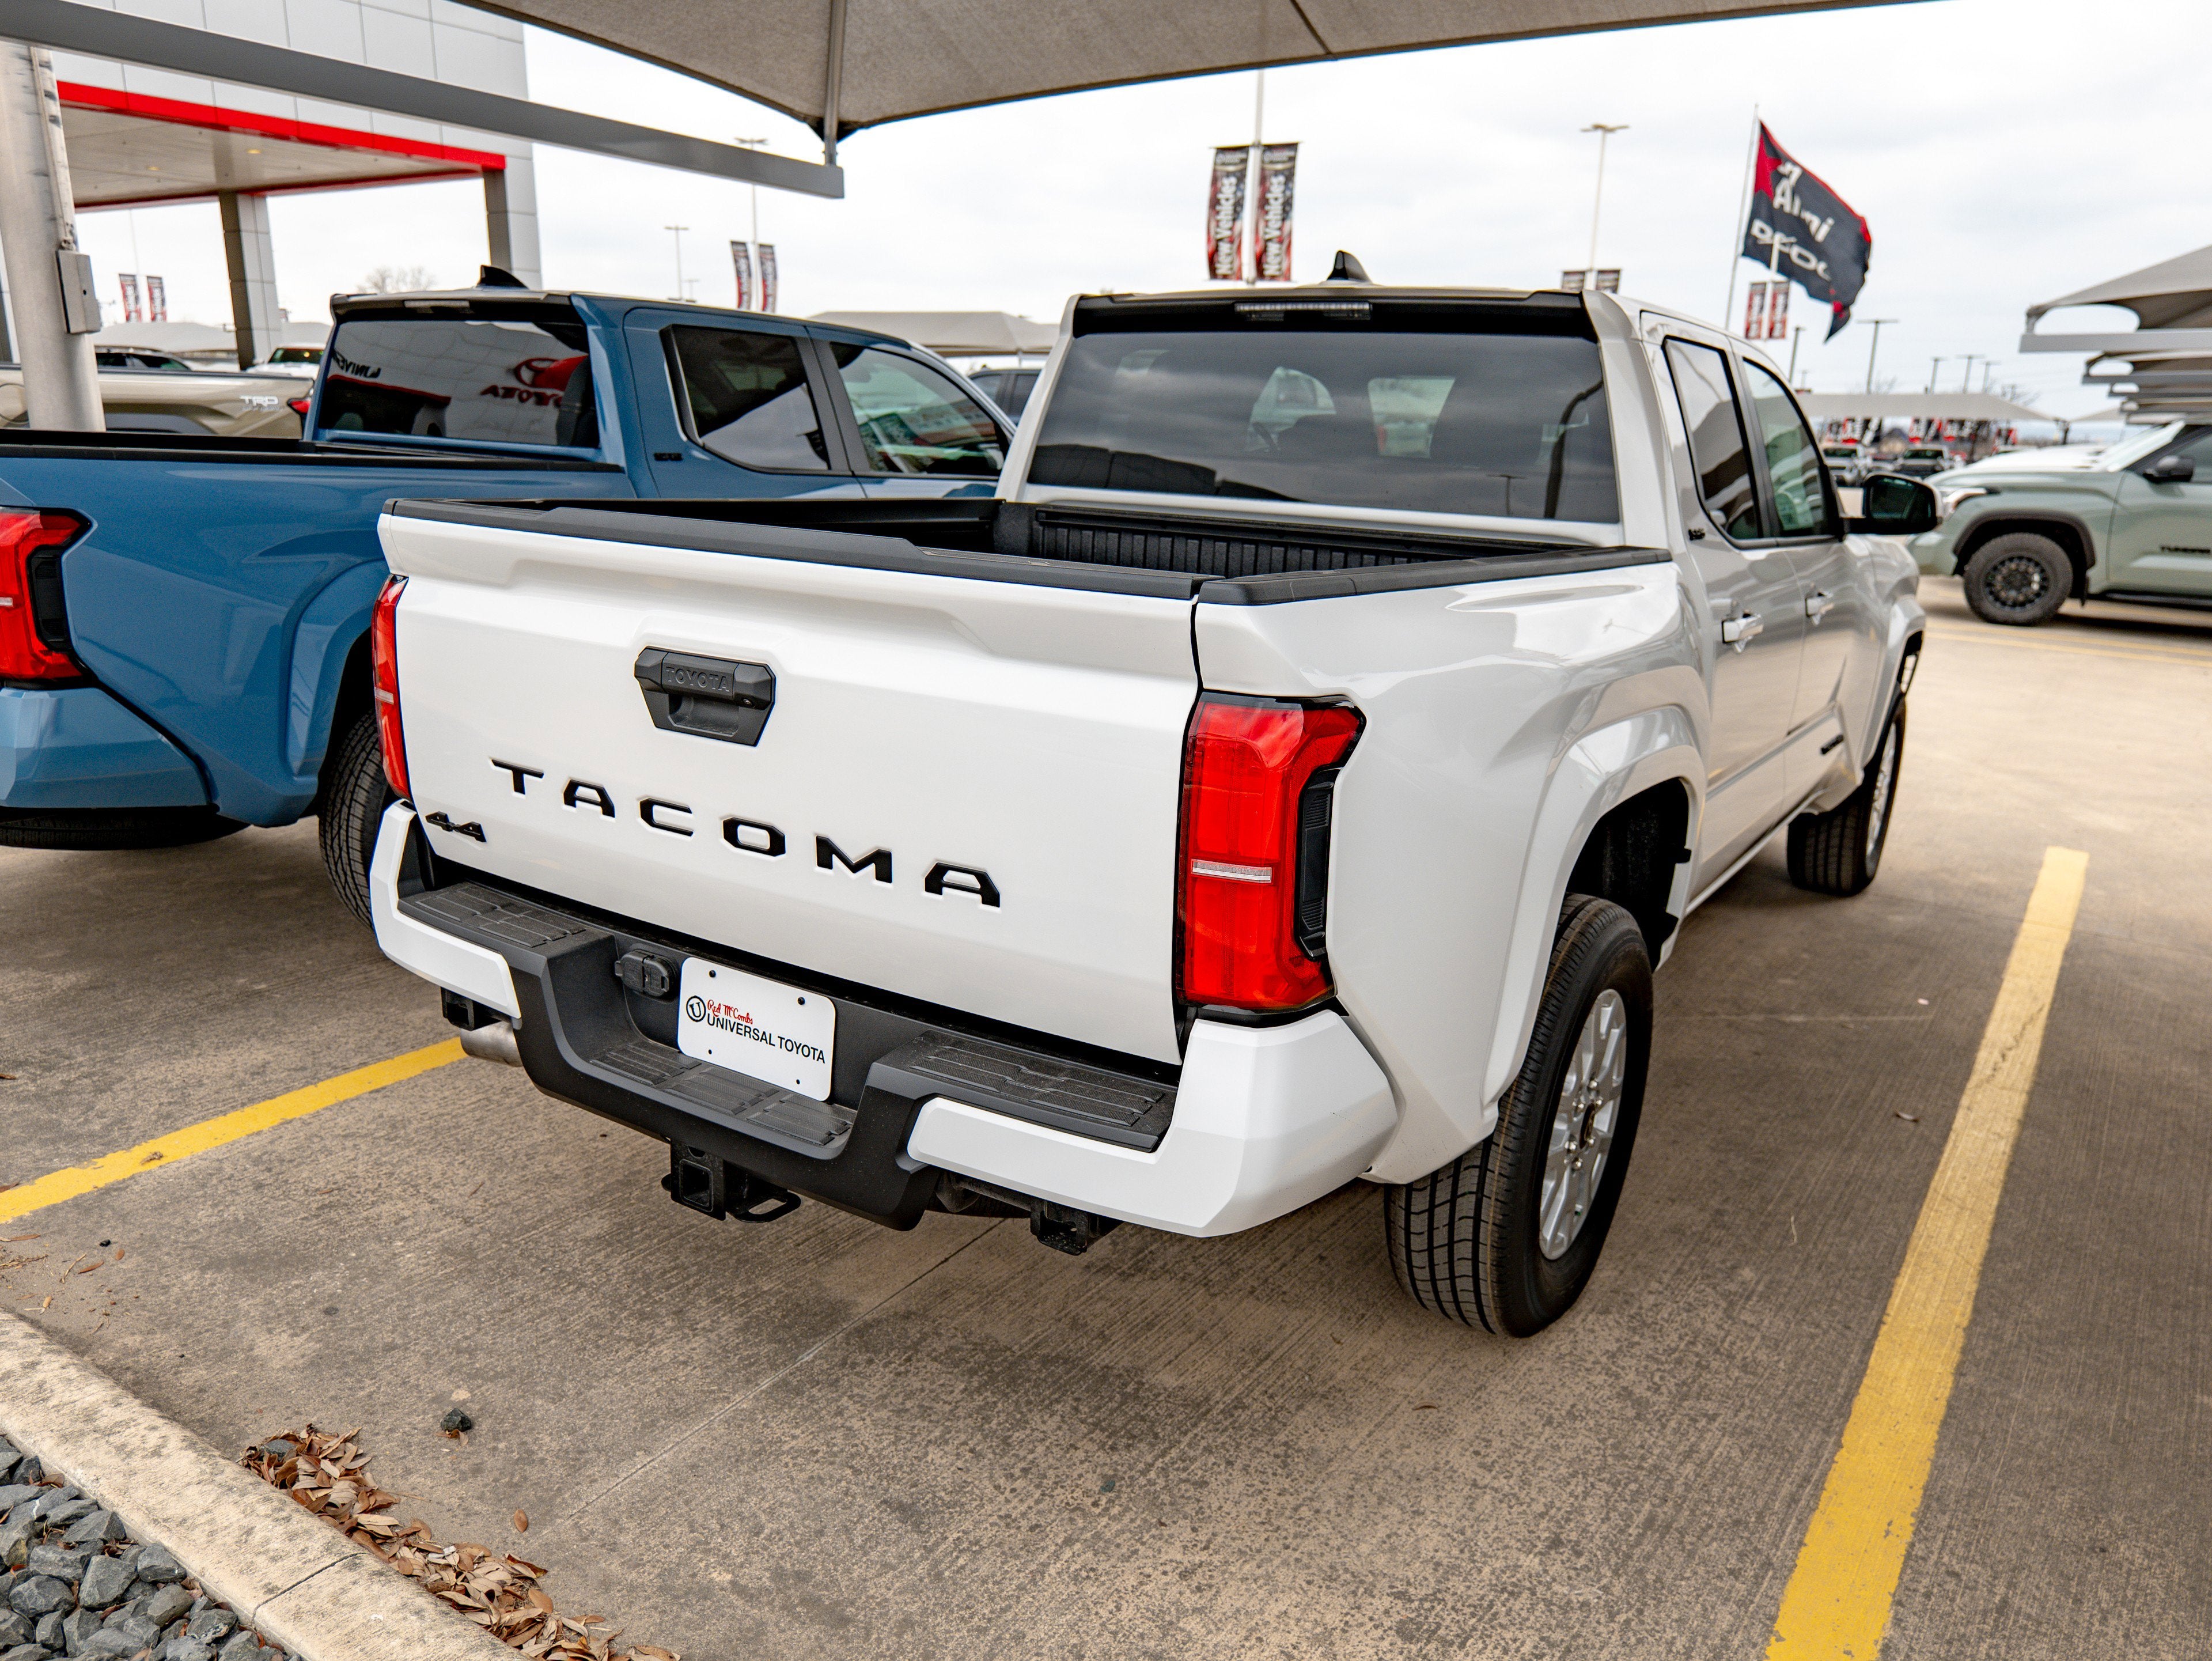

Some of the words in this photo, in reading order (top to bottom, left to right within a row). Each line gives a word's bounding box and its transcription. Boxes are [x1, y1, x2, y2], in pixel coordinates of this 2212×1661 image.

[1215, 175, 1237, 240] Vehicles
[1264, 175, 1286, 240] Vehicles
[1214, 241, 1234, 275] New
[1263, 241, 1283, 276] New
[240, 395, 279, 407] TRD
[666, 667, 730, 692] TOYOTA
[491, 758, 1001, 909] TACOMA
[707, 999, 721, 1017] Red
[722, 1004, 753, 1025] McCombs
[707, 1013, 776, 1047] UNIVERSAL
[778, 1036, 825, 1064] TOYOTA
